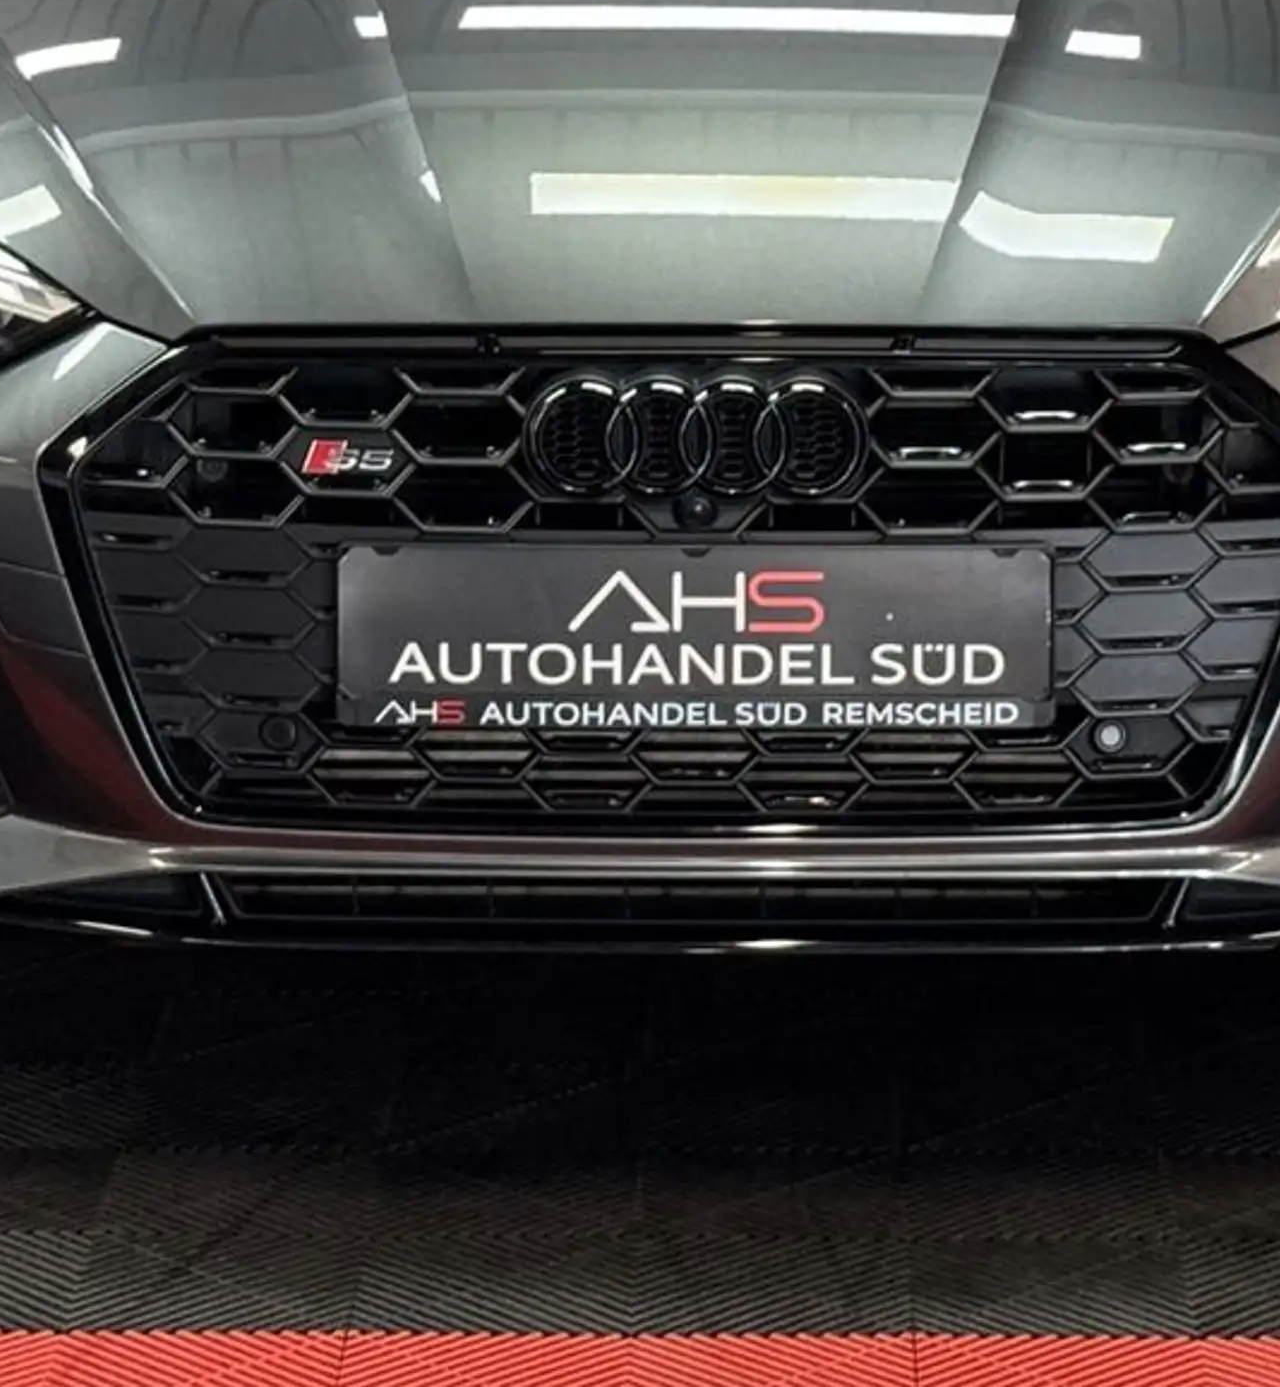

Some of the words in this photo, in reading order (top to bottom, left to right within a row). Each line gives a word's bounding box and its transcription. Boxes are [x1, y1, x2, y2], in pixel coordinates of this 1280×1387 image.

[322, 448, 395, 470] S5
[568, 570, 825, 633] AHS
[389, 642, 855, 686] AUTOHANDEL
[870, 642, 1006, 686] SÜD
[374, 699, 466, 725] AHS
[479, 701, 727, 726] AUTOHANDEL
[735, 701, 808, 726] SÜD
[822, 701, 1019, 726] REMSCHEID
